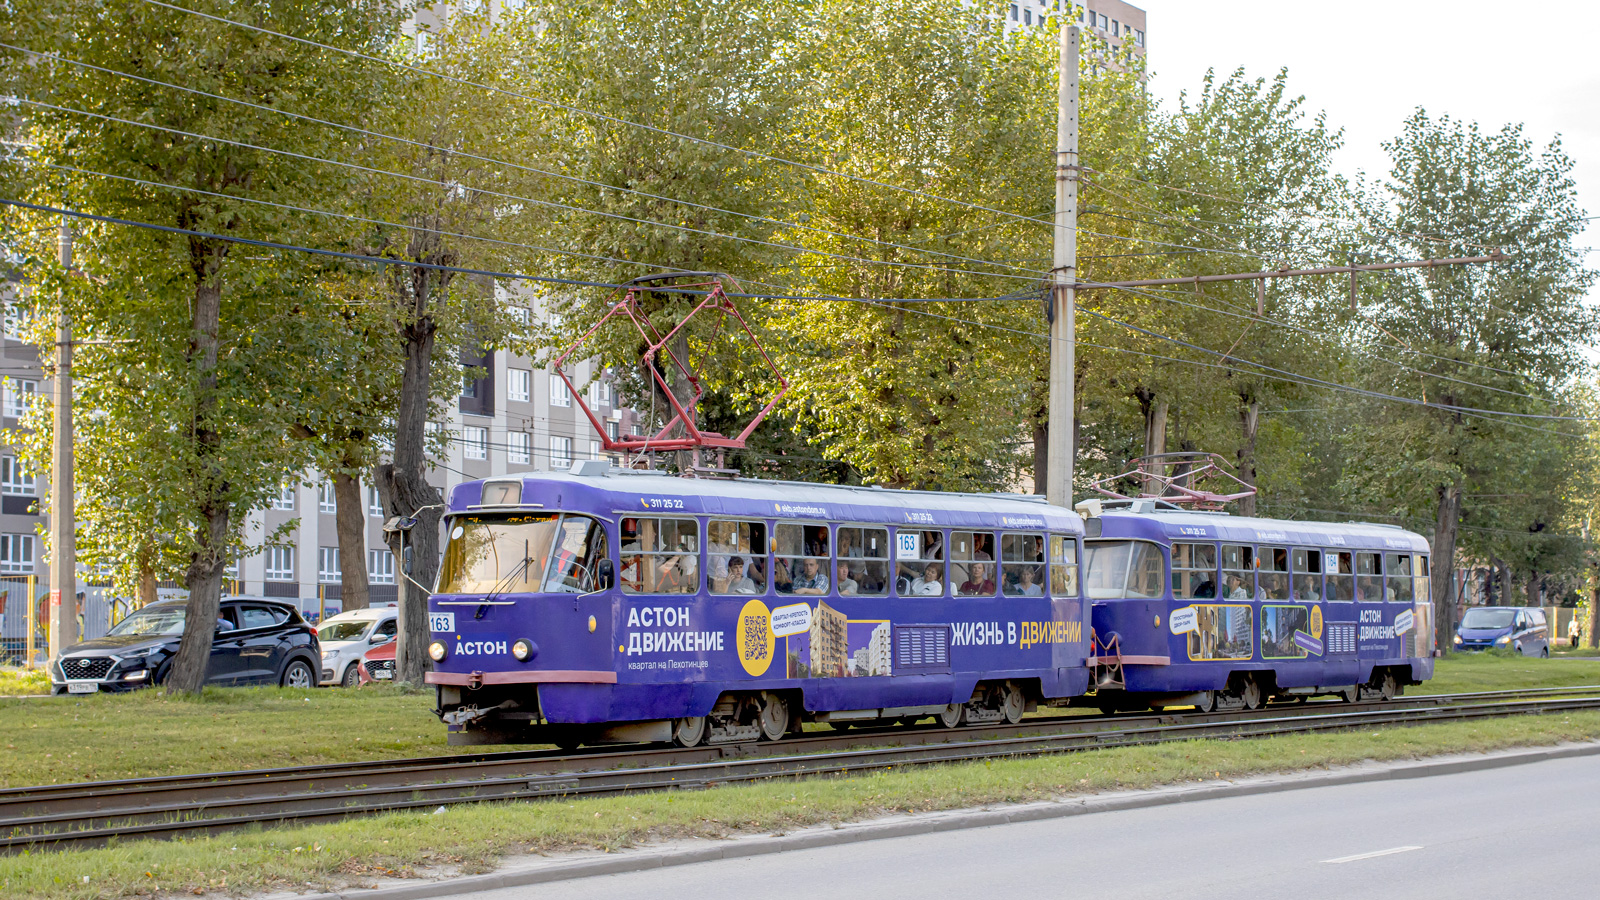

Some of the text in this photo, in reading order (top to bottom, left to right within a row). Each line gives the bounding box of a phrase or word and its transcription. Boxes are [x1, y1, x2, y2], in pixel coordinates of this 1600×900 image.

[499, 487, 509, 504] 7
[651, 498, 684, 509] 311 25 22
[782, 504, 826, 515] ekb.astondom.ru
[919, 512, 926, 521] 25
[926, 513, 933, 521] 22
[900, 535, 915, 551] 163
[1327, 554, 1337, 567] 164
[627, 606, 690, 627] АСТОН
[1360, 610, 1381, 623] АСТОН
[430, 617, 450, 631] 163
[951, 621, 1082, 650] ЖИЗНЬ В ДВИЖЕНИИ
[1360, 625, 1395, 641] ДВИЖЕНИЕ
[455, 641, 507, 656] АСТОН
[627, 631, 724, 656] ДВИЖЕНИЕ
[628, 659, 709, 672] квартал на Пехотинцев
